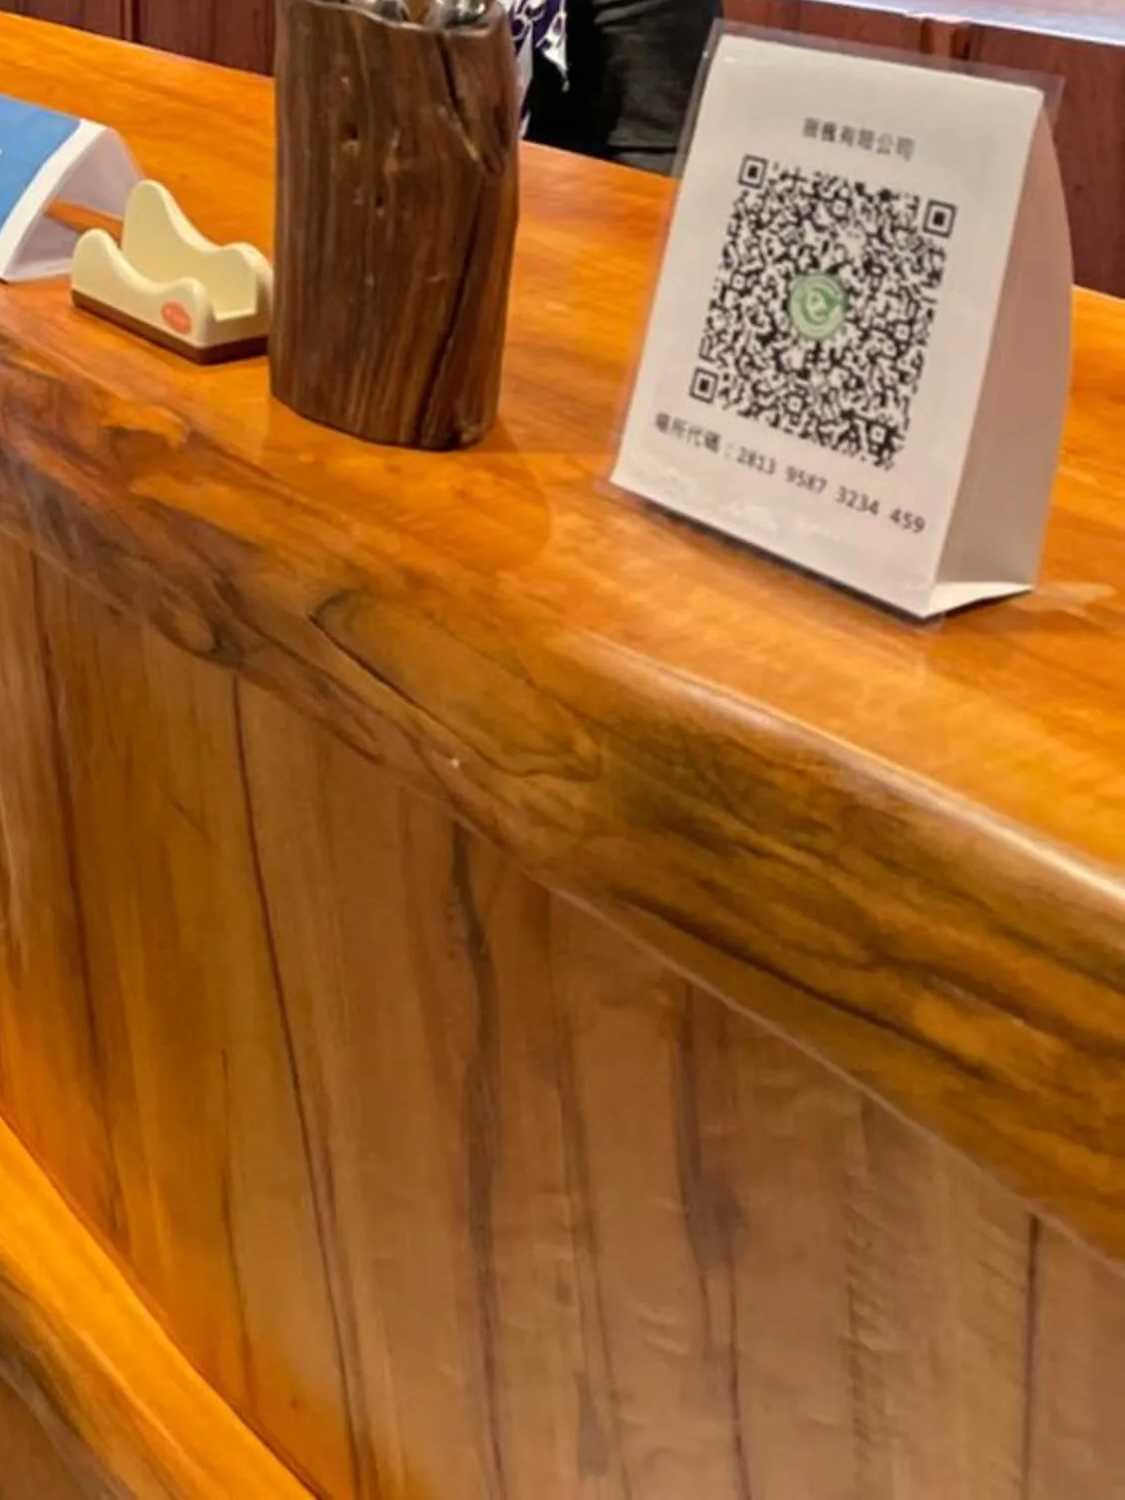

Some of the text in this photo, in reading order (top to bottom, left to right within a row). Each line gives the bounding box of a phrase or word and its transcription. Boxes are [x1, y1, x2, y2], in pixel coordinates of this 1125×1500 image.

[785, 466, 828, 495] 9587
[835, 485, 880, 516] 3234
[889, 508, 927, 534] 459
